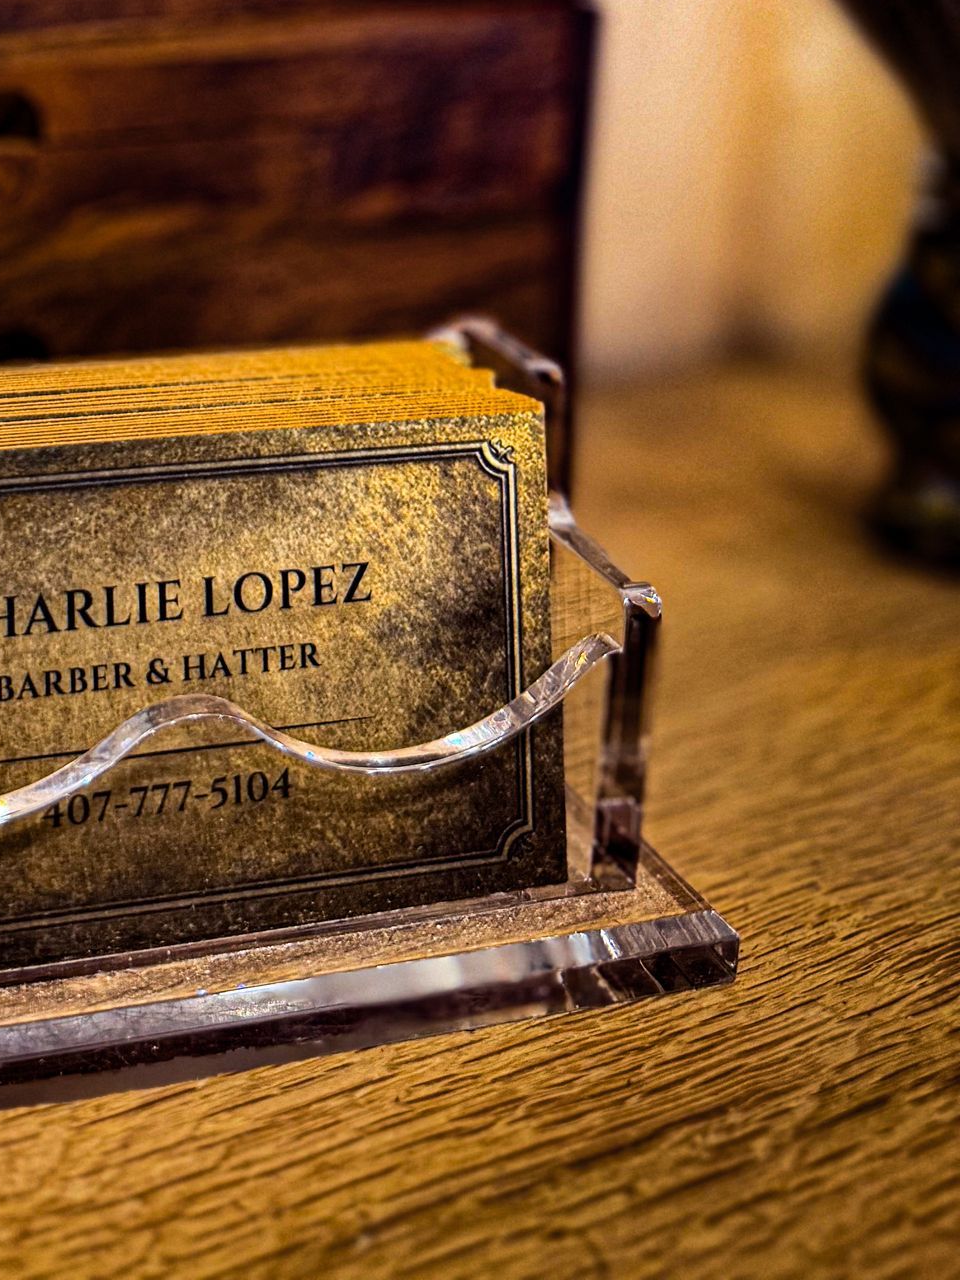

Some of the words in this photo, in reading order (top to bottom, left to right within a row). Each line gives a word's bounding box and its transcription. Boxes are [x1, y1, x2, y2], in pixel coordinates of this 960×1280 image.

[202, 561, 373, 618] LOPEZ
[145, 657, 171, 686] &
[182, 642, 321, 682] HATTER
[43, 767, 293, 829] 407-777-5104
